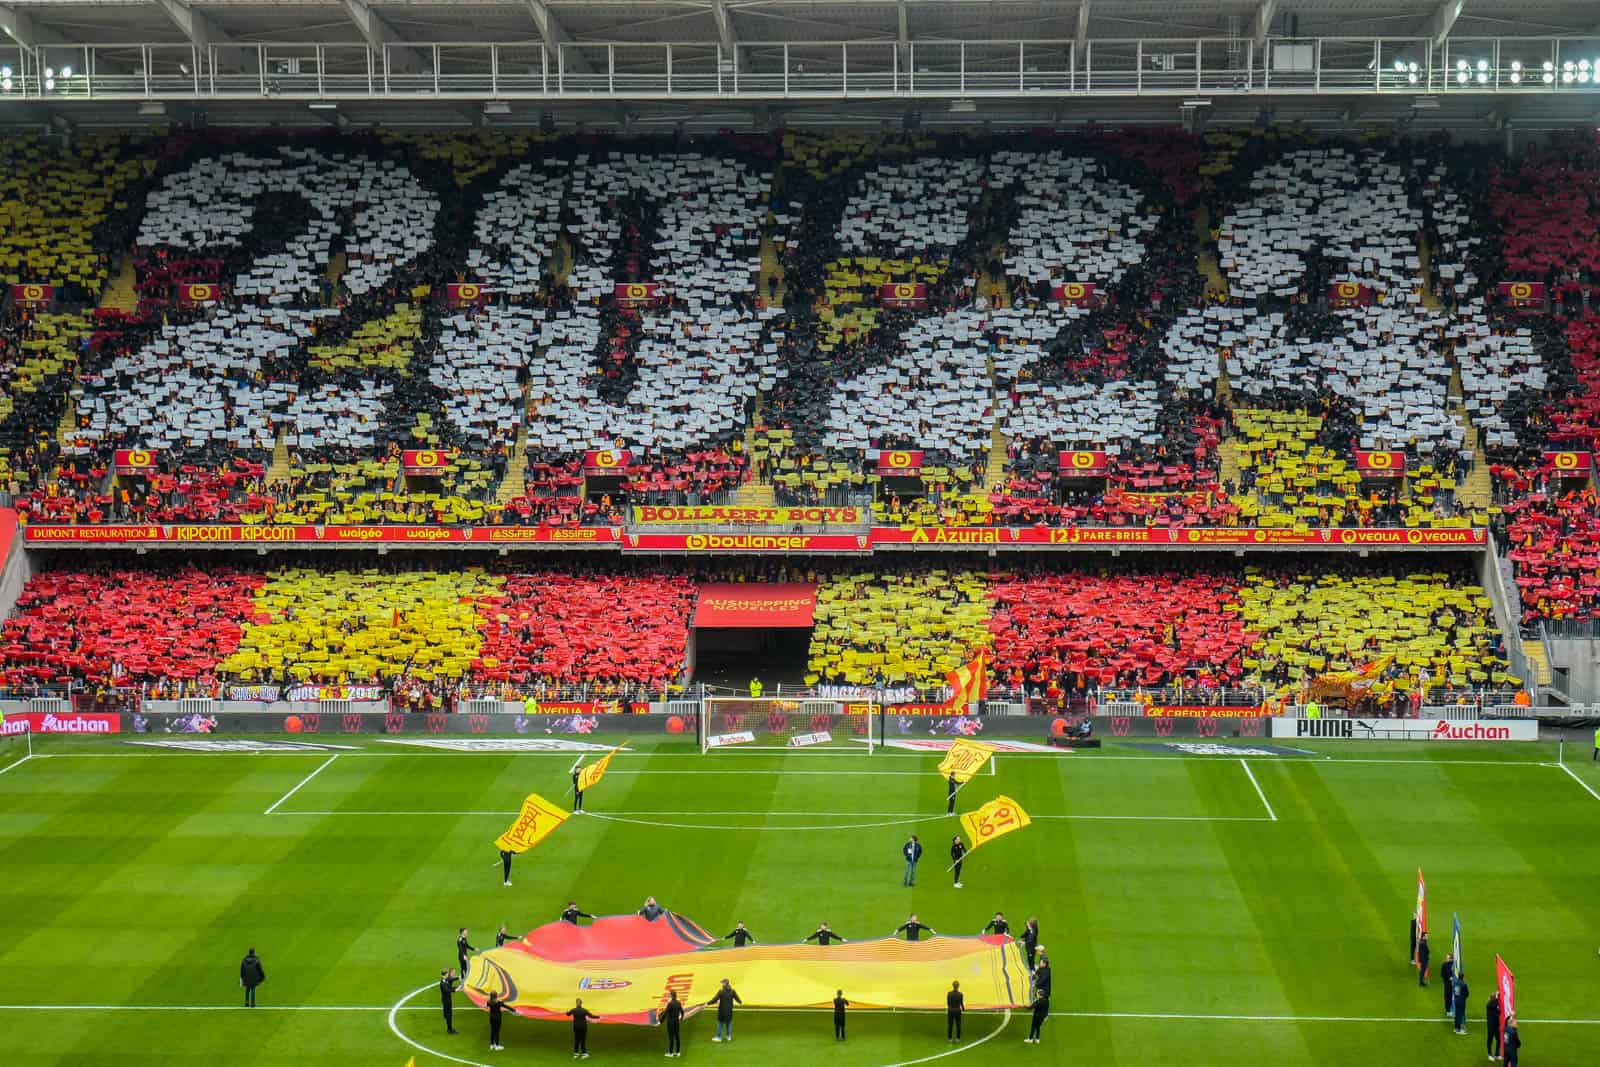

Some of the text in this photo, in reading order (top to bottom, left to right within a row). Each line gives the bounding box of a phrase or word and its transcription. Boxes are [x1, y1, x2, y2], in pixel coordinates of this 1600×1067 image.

[641, 506, 857, 522] BOLLAERT BOYS
[33, 528, 146, 538] DUPONT RESTAURATION
[177, 526, 296, 540] KIPCOM KIPCOM
[709, 532, 810, 549] boulanger
[935, 527, 1001, 544] Azurial
[1083, 531, 1149, 541] PARE-BRISE
[1358, 532, 1467, 542] VEOLIA VEOLIA
[41, 713, 110, 733] Auchan
[1296, 719, 1353, 738] PUMA
[1433, 719, 1510, 739] Auchan
